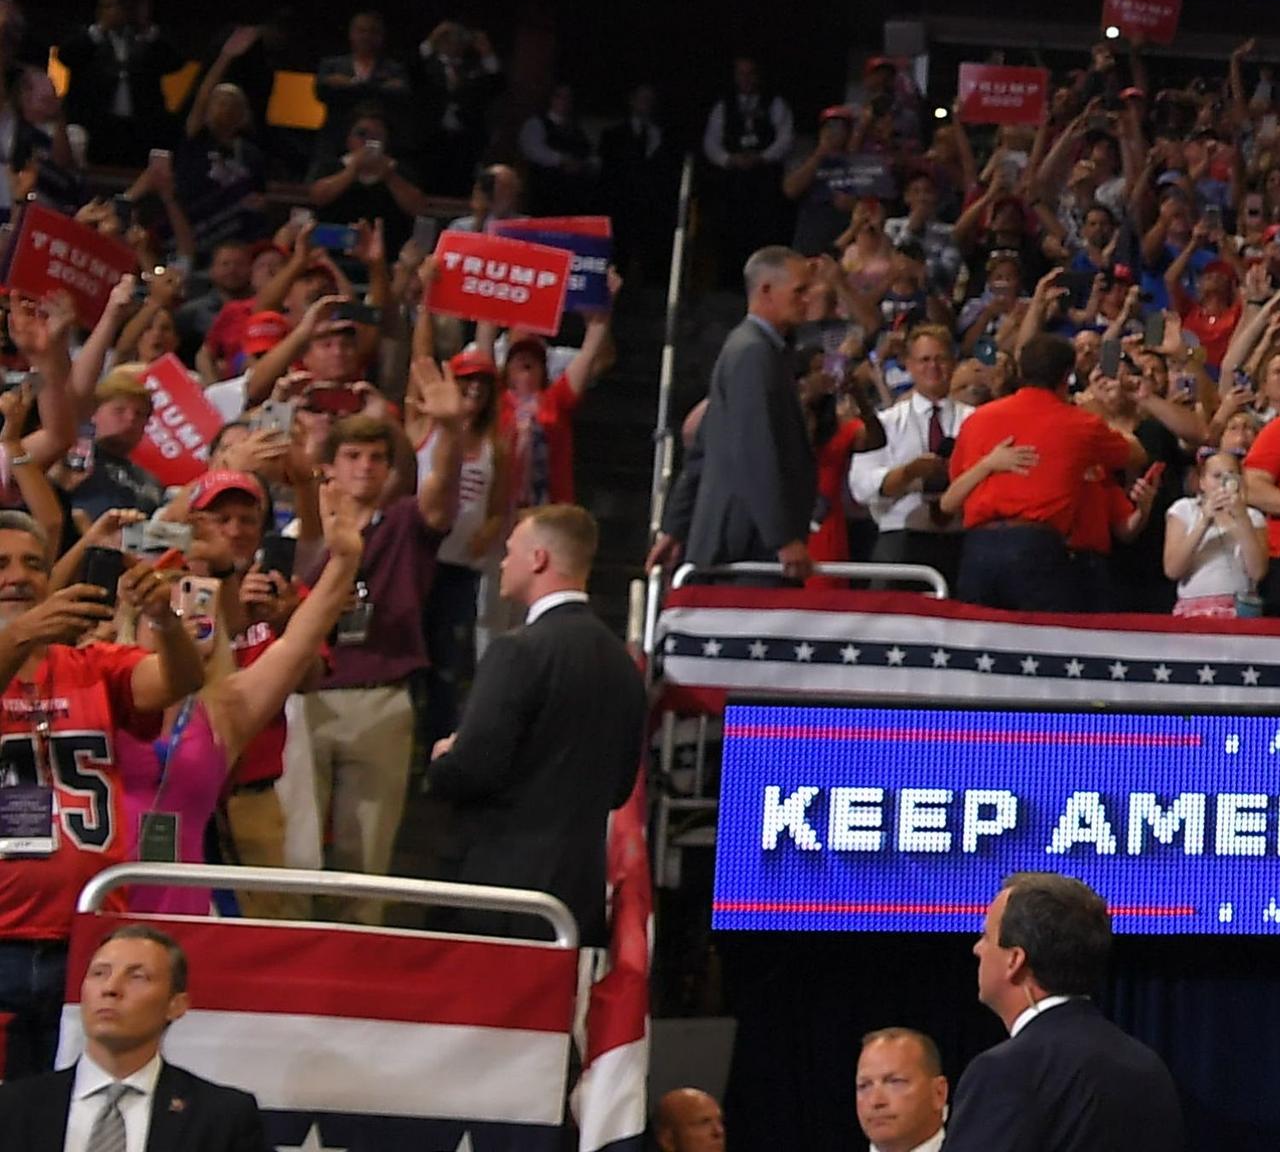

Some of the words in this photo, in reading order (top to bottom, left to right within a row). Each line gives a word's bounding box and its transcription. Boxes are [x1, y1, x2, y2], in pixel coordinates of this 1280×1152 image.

[968, 80, 1038, 96] TRUMP
[443, 251, 557, 290] TRUMP
[568, 255, 608, 274] ORE
[462, 278, 529, 304] 2020
[760, 784, 1019, 854] KEEP
